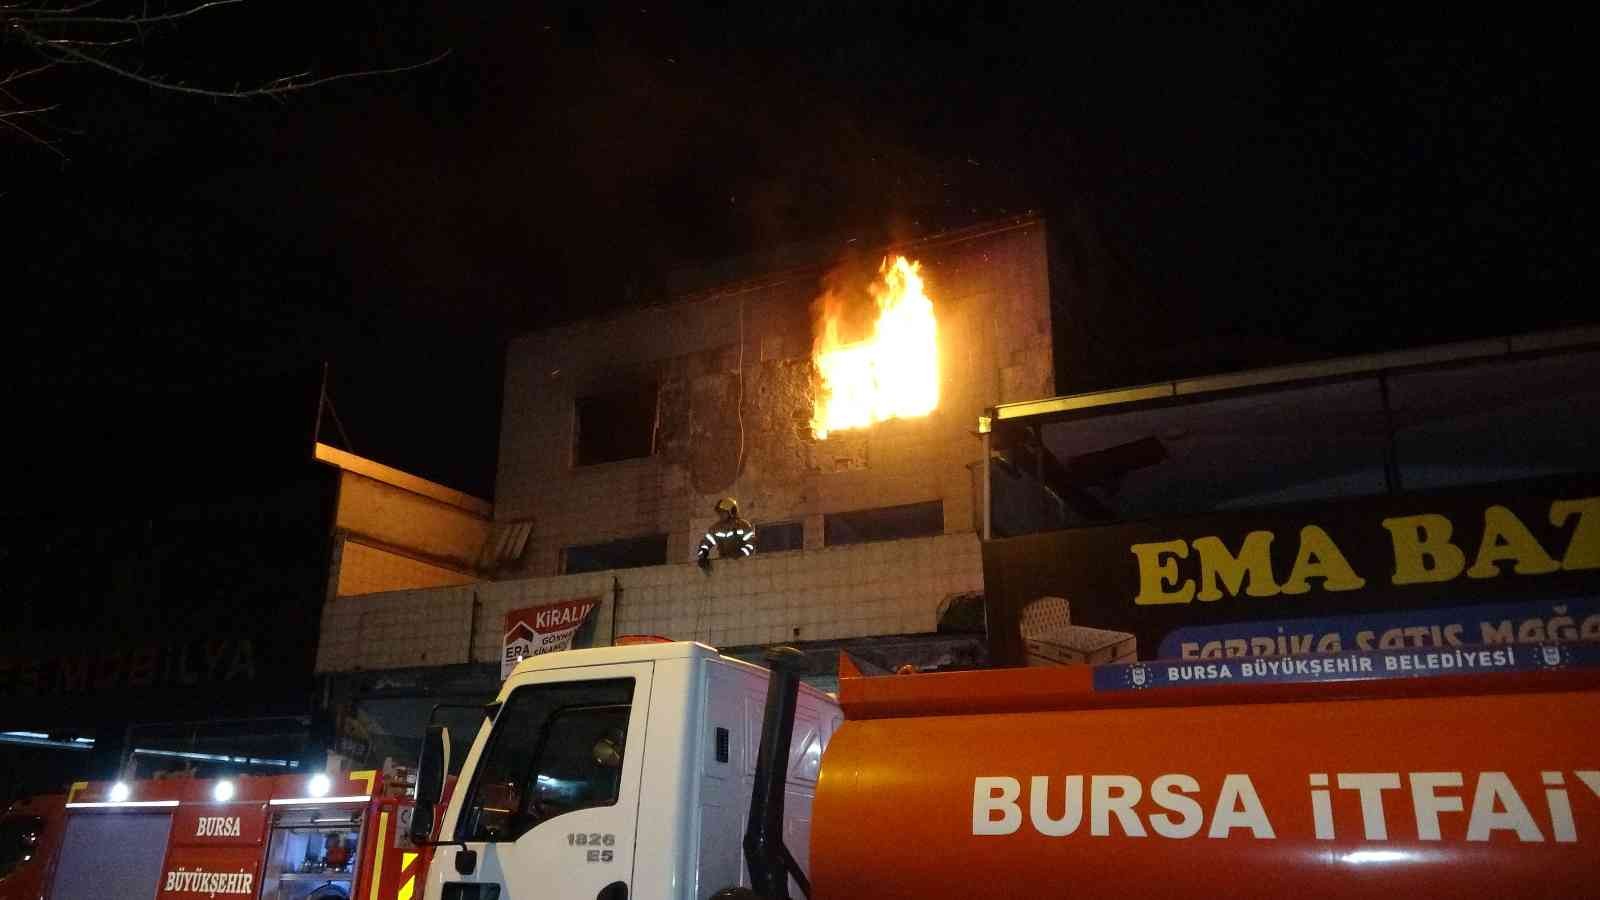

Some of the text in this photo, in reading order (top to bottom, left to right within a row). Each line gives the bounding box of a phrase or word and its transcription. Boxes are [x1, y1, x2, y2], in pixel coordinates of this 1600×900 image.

[1131, 525, 1366, 605] EMA
[506, 644, 529, 659] ERA
[1168, 649, 1514, 681] BURSA BÜYÜKŞEHİR BELEDİYESİ
[972, 773, 1276, 839] BURSA
[196, 816, 241, 837] BURSA
[566, 832, 616, 848] 1826
[586, 850, 613, 862] E5
[163, 869, 253, 899] BÜYÜKŞEHİR
